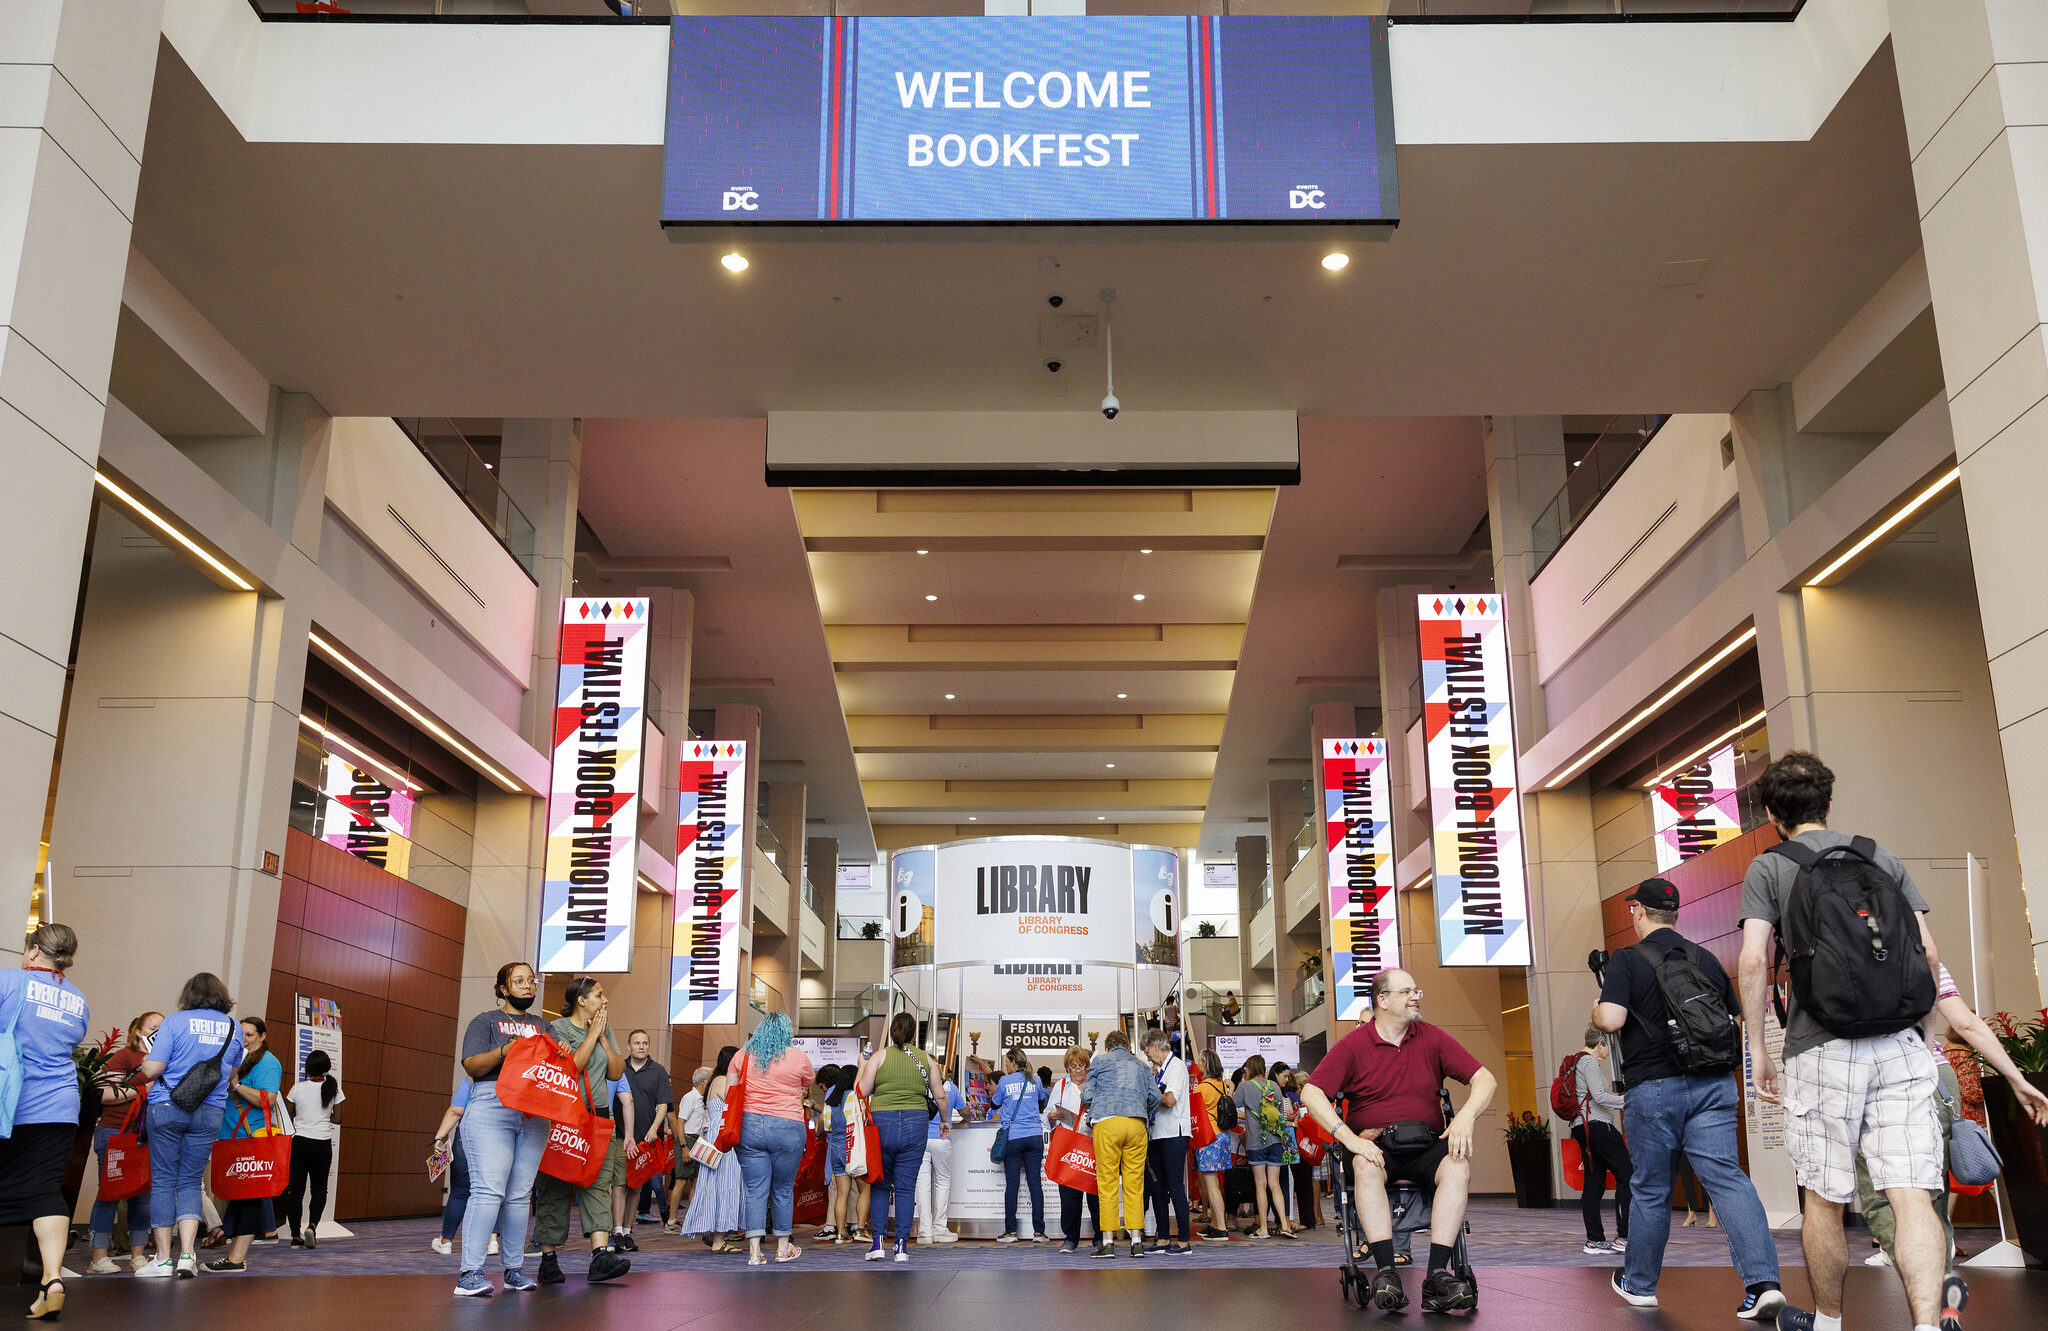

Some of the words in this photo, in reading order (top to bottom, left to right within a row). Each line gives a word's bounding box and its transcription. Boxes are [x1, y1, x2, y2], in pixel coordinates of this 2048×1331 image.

[896, 71, 1151, 109] WELCOME
[907, 133, 1139, 167] BOOKFEST
[722, 191, 759, 210] DC
[1289, 190, 1326, 209] DC
[579, 636, 624, 745] FESTIVAL
[1445, 633, 1488, 742] FESTIVAL
[574, 748, 618, 815] BOOK
[1451, 743, 1494, 811] BOOK
[697, 771, 728, 852] FESTIVAL
[1342, 768, 1371, 851] FESTIVAL
[566, 822, 613, 941] NATIONAL
[693, 855, 724, 907] BOOK
[976, 865, 1092, 915] LIBRARY
[1347, 853, 1377, 904] BOOK
[1457, 817, 1504, 936] NATIONAL
[1018, 916, 1063, 925] LIBRARY
[1018, 925, 1033, 935] OF
[1034, 925, 1089, 936] CONGRESS
[688, 912, 722, 1001] NATIONAL
[26, 980, 60, 1007] EVENT
[59, 989, 84, 1016] STAFF
[1027, 984, 1037, 992] OF
[1038, 984, 1083, 992] CONGRESS
[189, 1018, 215, 1034] EVENT
[1005, 1034, 1076, 1047] SPONSORS
[1010, 1022, 1071, 1034] FESTIVAL
